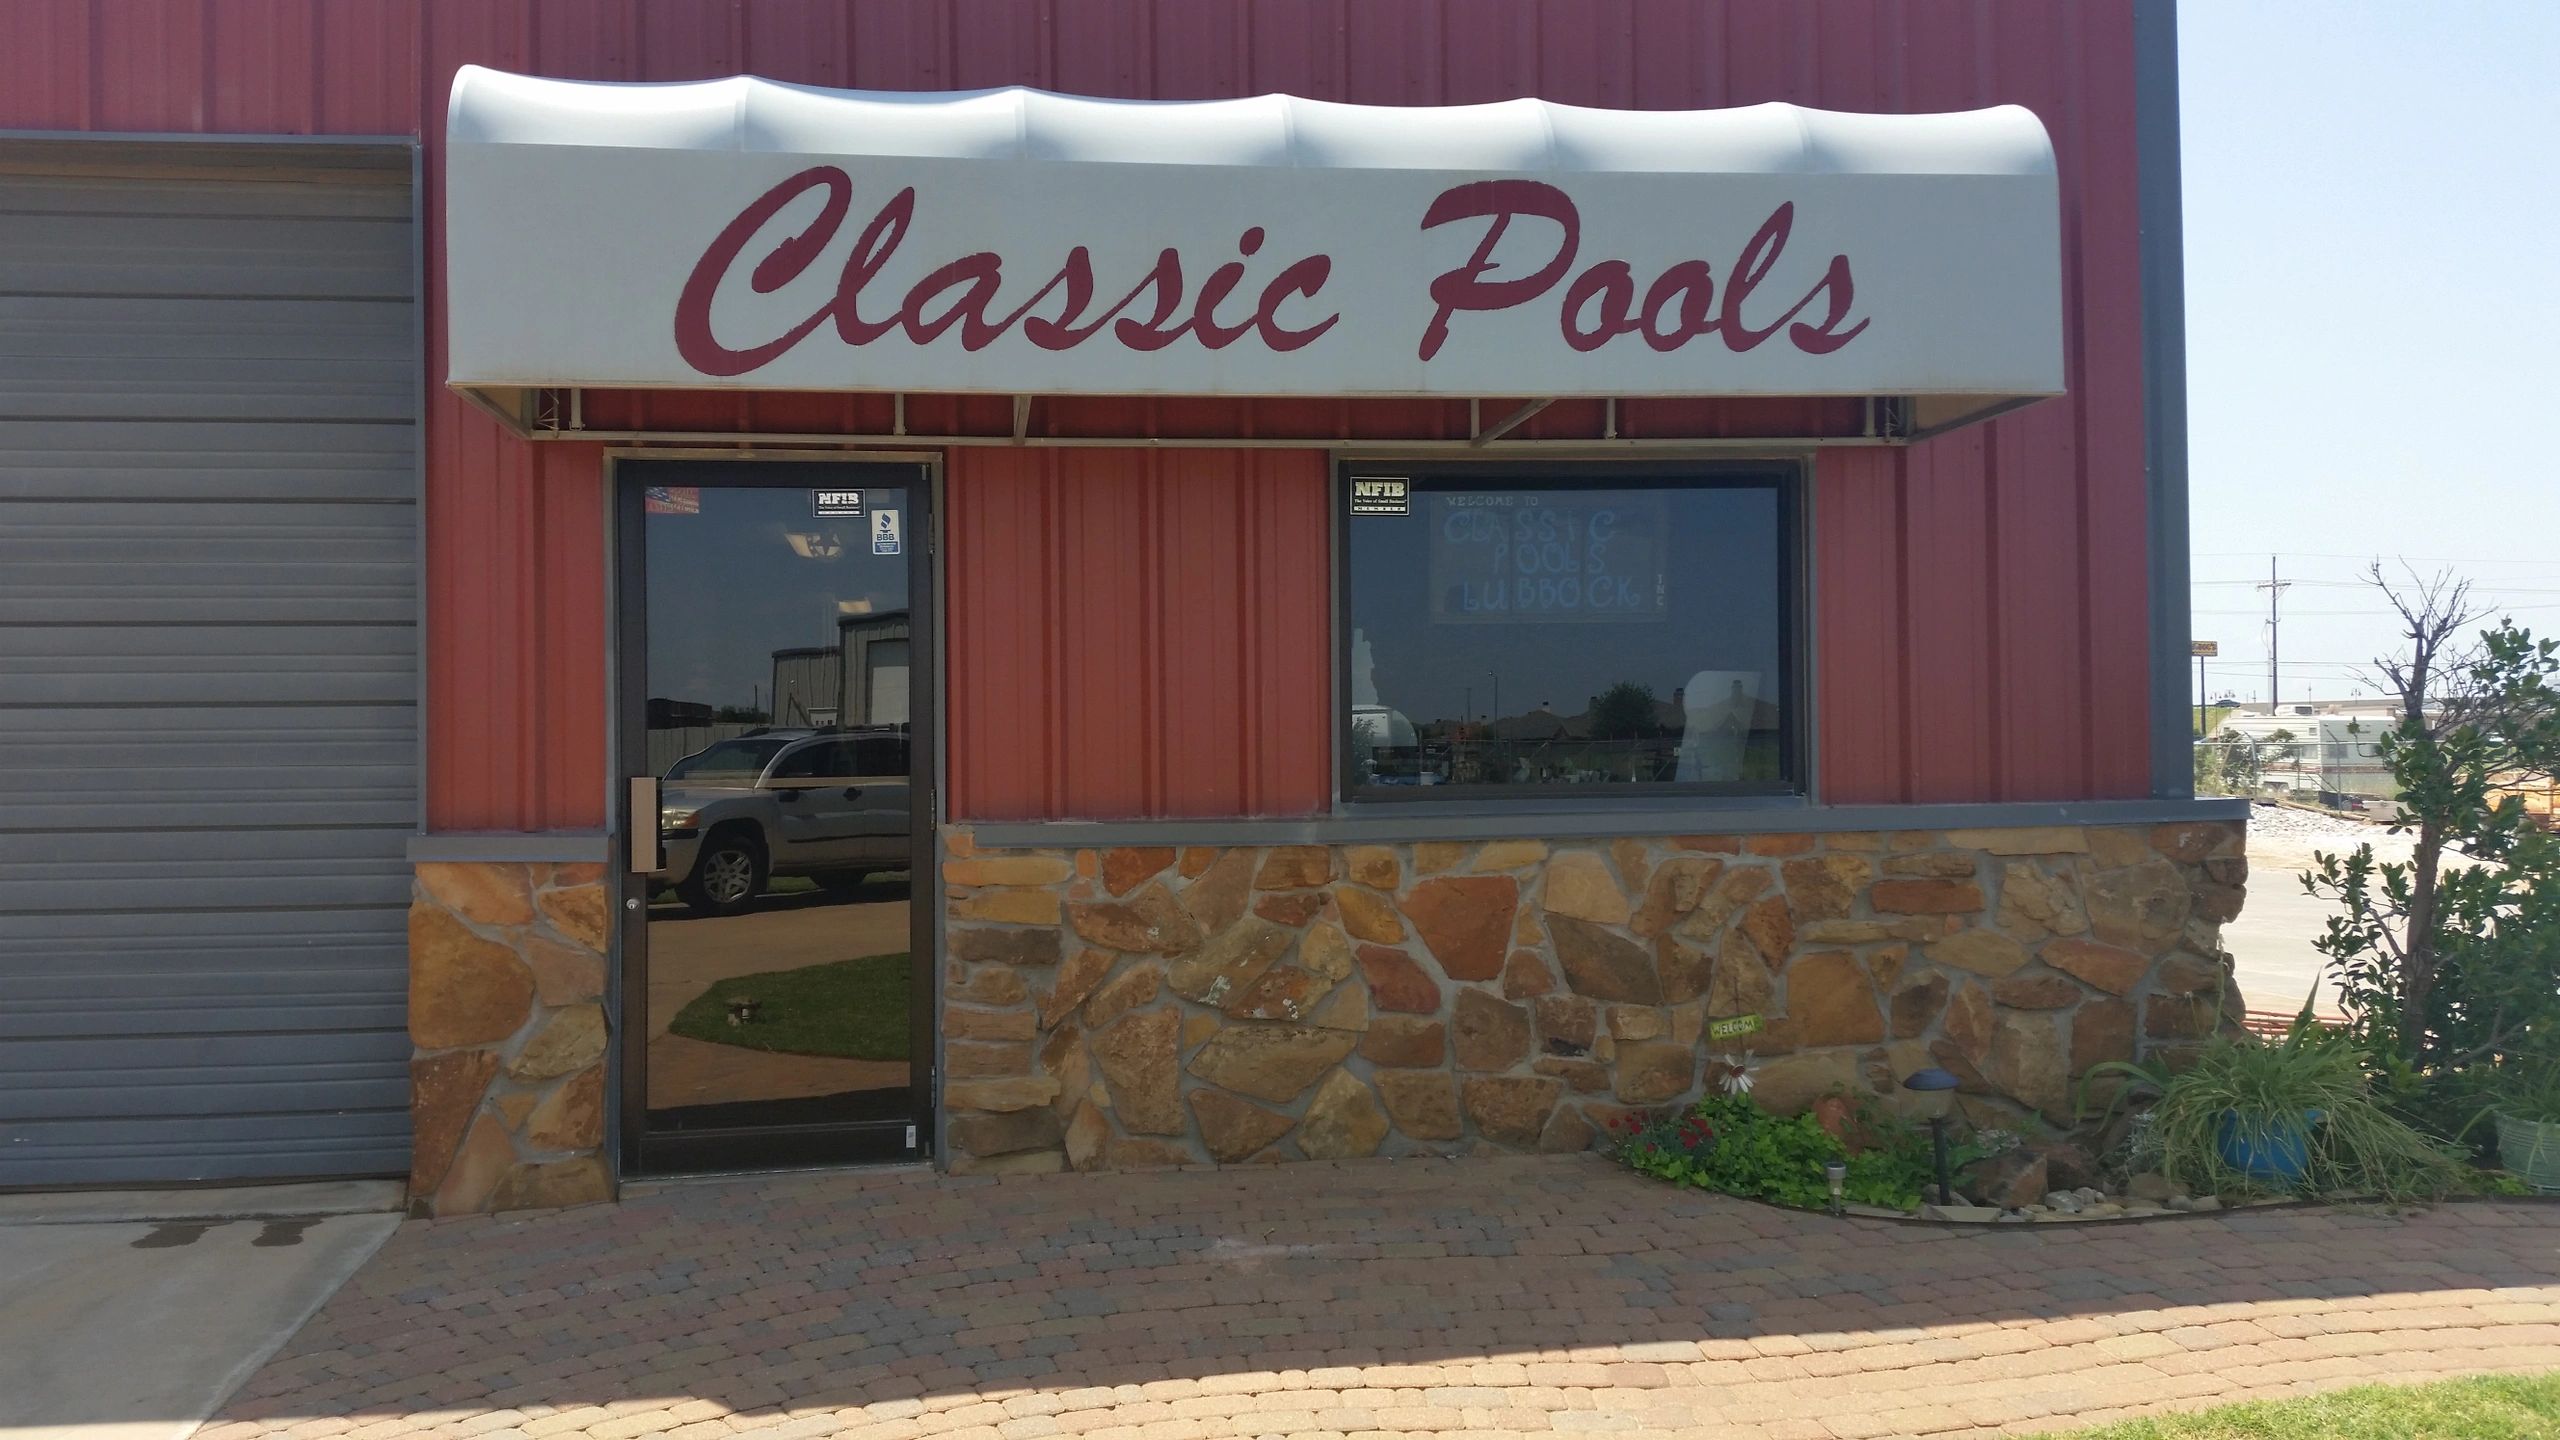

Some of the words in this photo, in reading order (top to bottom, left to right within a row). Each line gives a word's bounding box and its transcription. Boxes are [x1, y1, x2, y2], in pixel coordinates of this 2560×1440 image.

[674, 165, 1339, 377] Classic
[1419, 179, 1871, 362] Pools
[1355, 482, 1405, 497] NFIB
[818, 492, 859, 504] NFIB
[1446, 496, 1514, 507] WELCOME
[1525, 496, 1539, 507] TO
[876, 533, 895, 541] BBB
